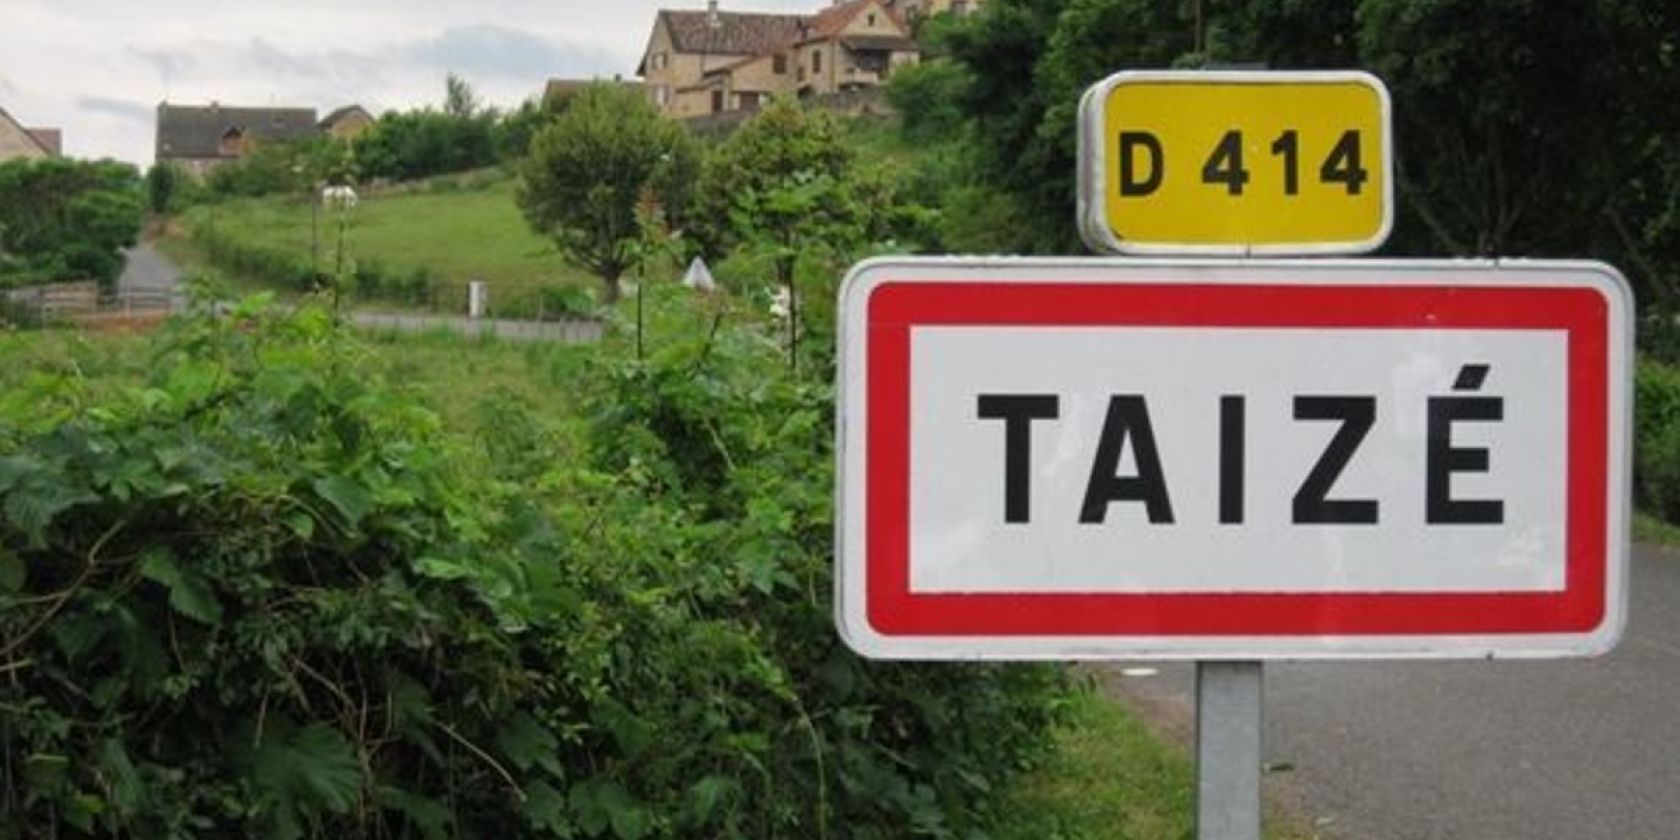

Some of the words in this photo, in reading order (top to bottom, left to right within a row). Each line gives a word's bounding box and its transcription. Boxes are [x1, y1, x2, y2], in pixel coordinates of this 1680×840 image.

[1118, 131, 1164, 198] D
[1201, 129, 1369, 197] 414
[977, 364, 1505, 525] TAIZÉ
